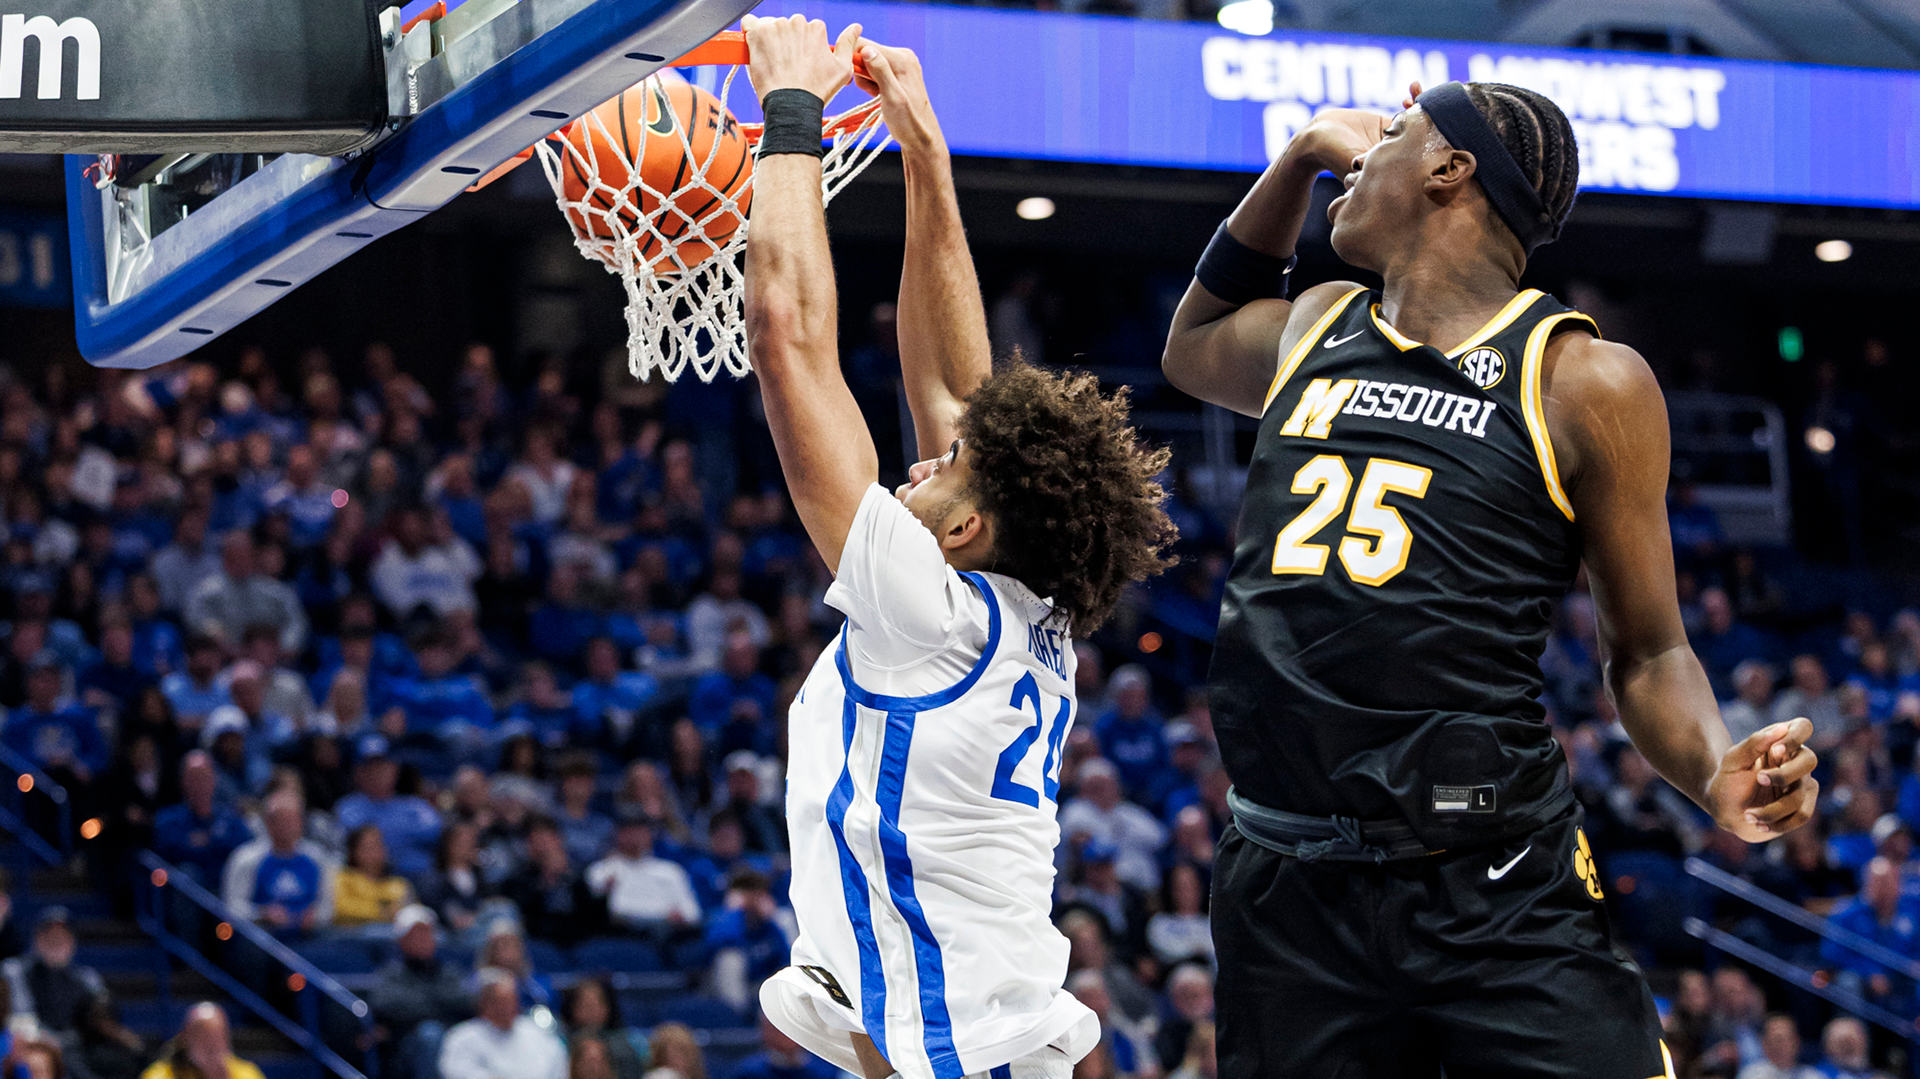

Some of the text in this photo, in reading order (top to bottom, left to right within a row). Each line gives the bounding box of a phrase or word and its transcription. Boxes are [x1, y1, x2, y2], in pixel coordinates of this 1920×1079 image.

[1463, 349, 1503, 387] SEC
[1279, 378, 1496, 439] MISSOURI
[1271, 453, 1433, 587] 25
[1479, 793, 1486, 806] L
